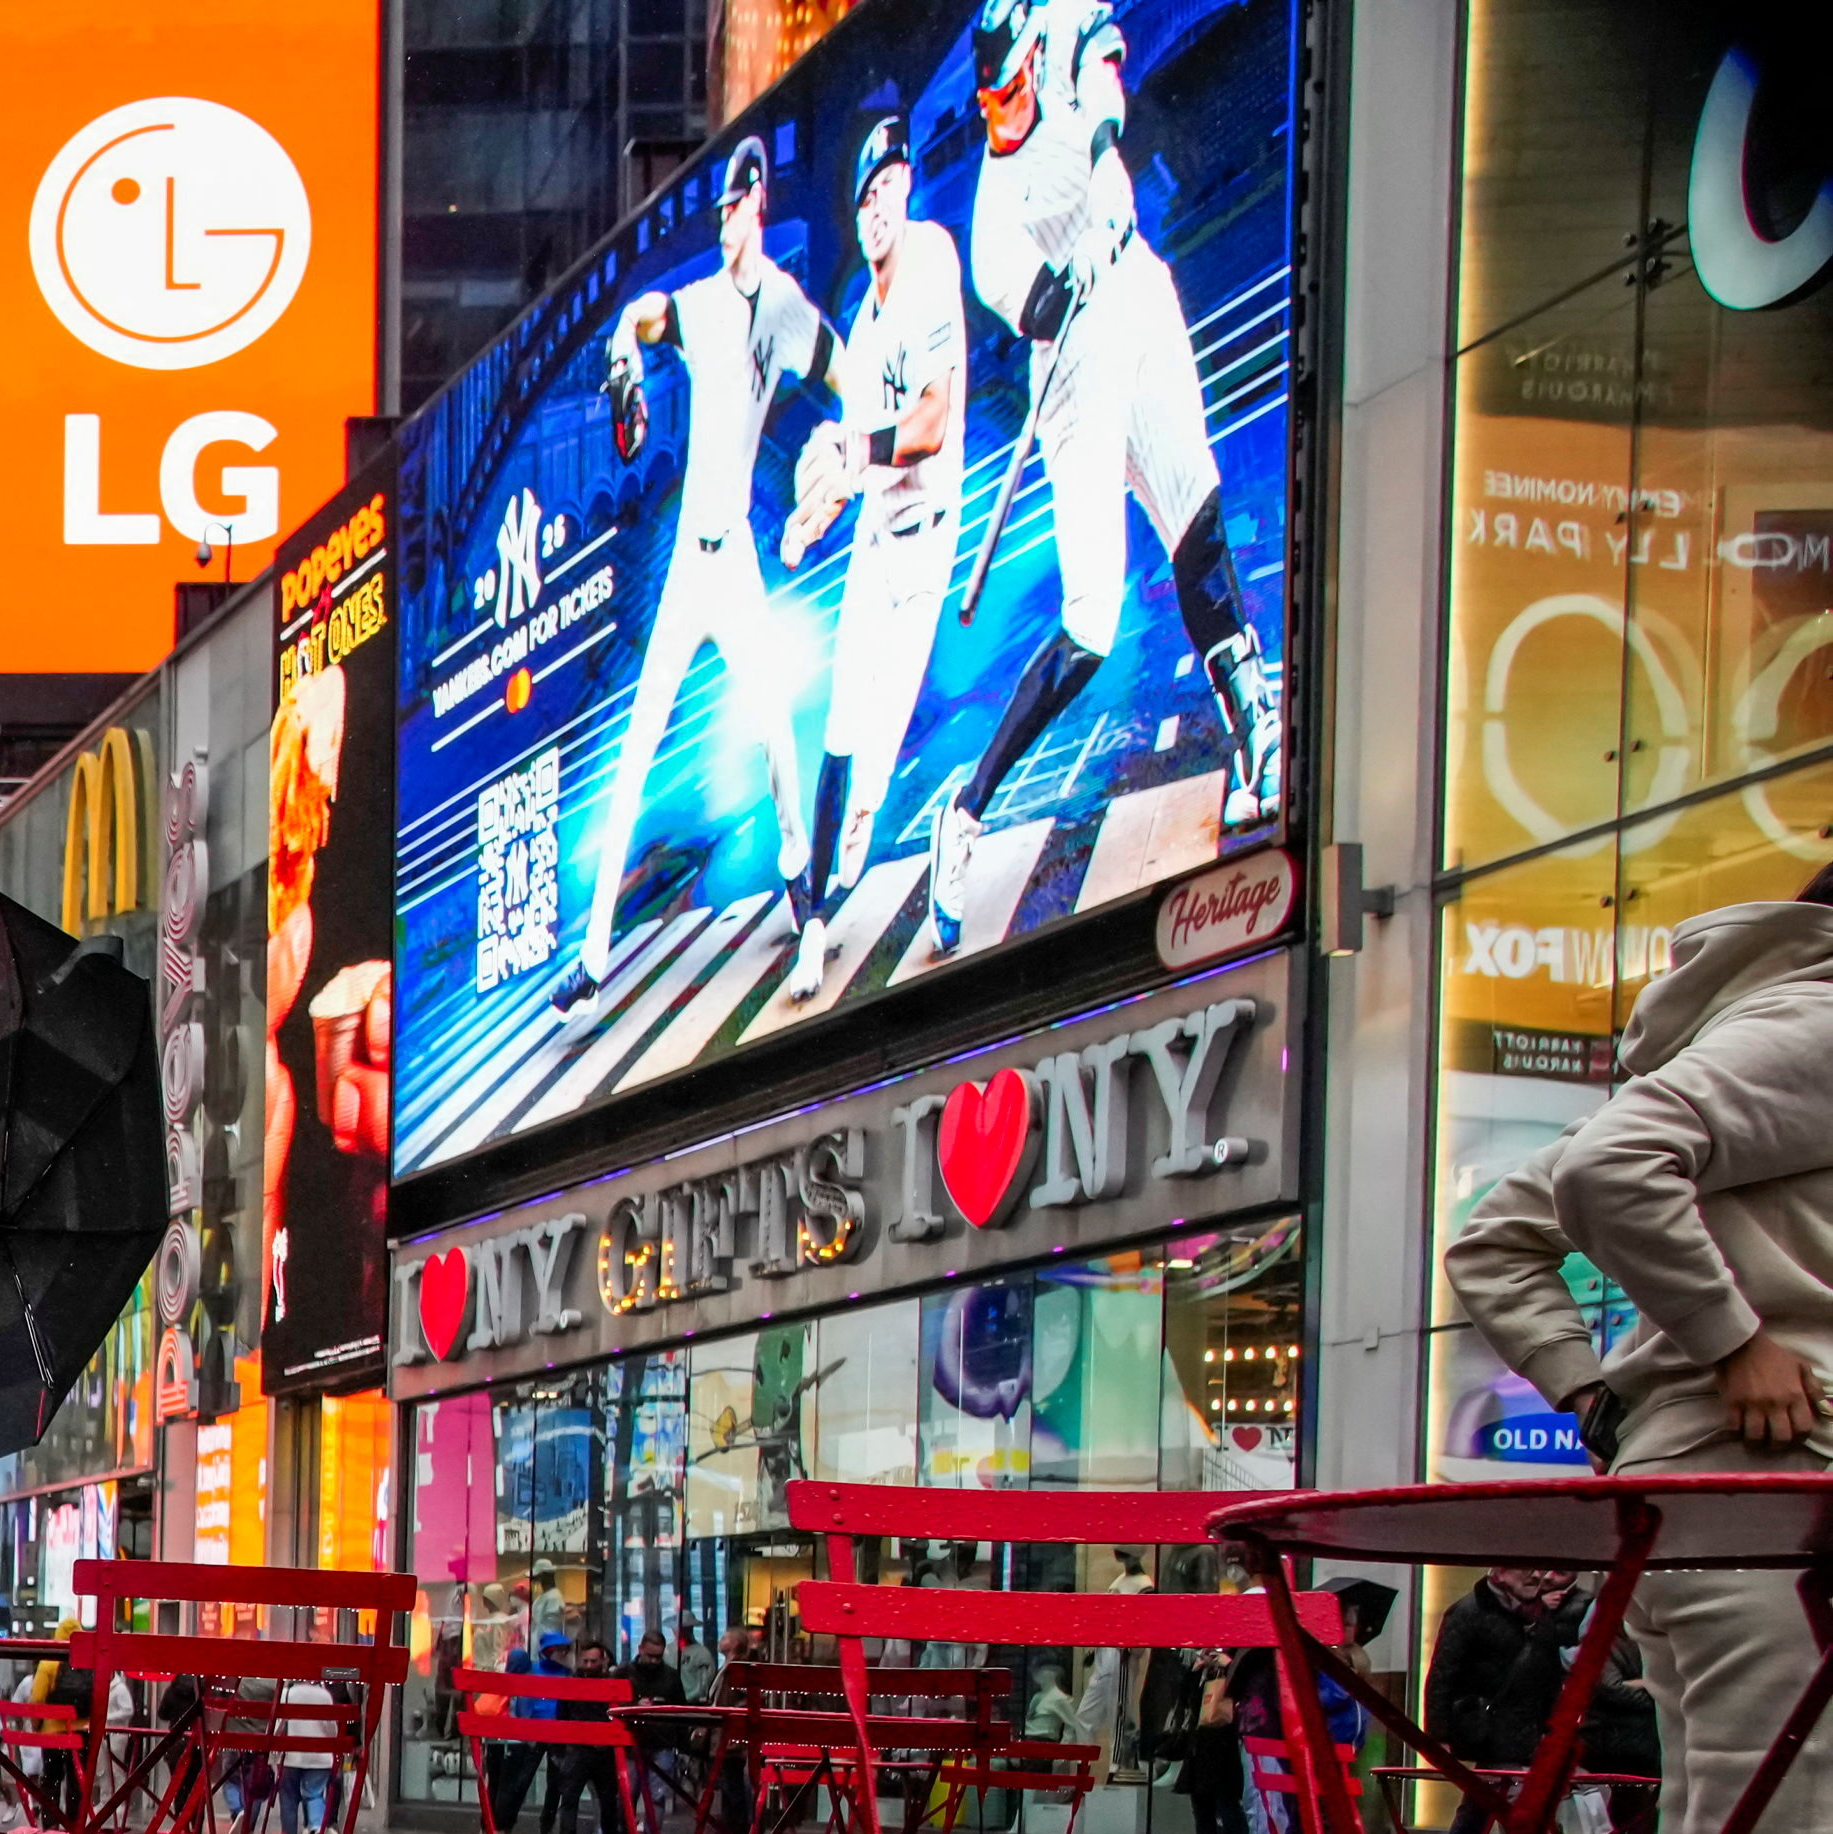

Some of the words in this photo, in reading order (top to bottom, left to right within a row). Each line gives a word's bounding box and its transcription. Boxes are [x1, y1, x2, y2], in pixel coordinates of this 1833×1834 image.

[63, 410, 280, 546] LG
[1168, 871, 1284, 950] Heritage
[596, 1127, 867, 1317] GIFTS
